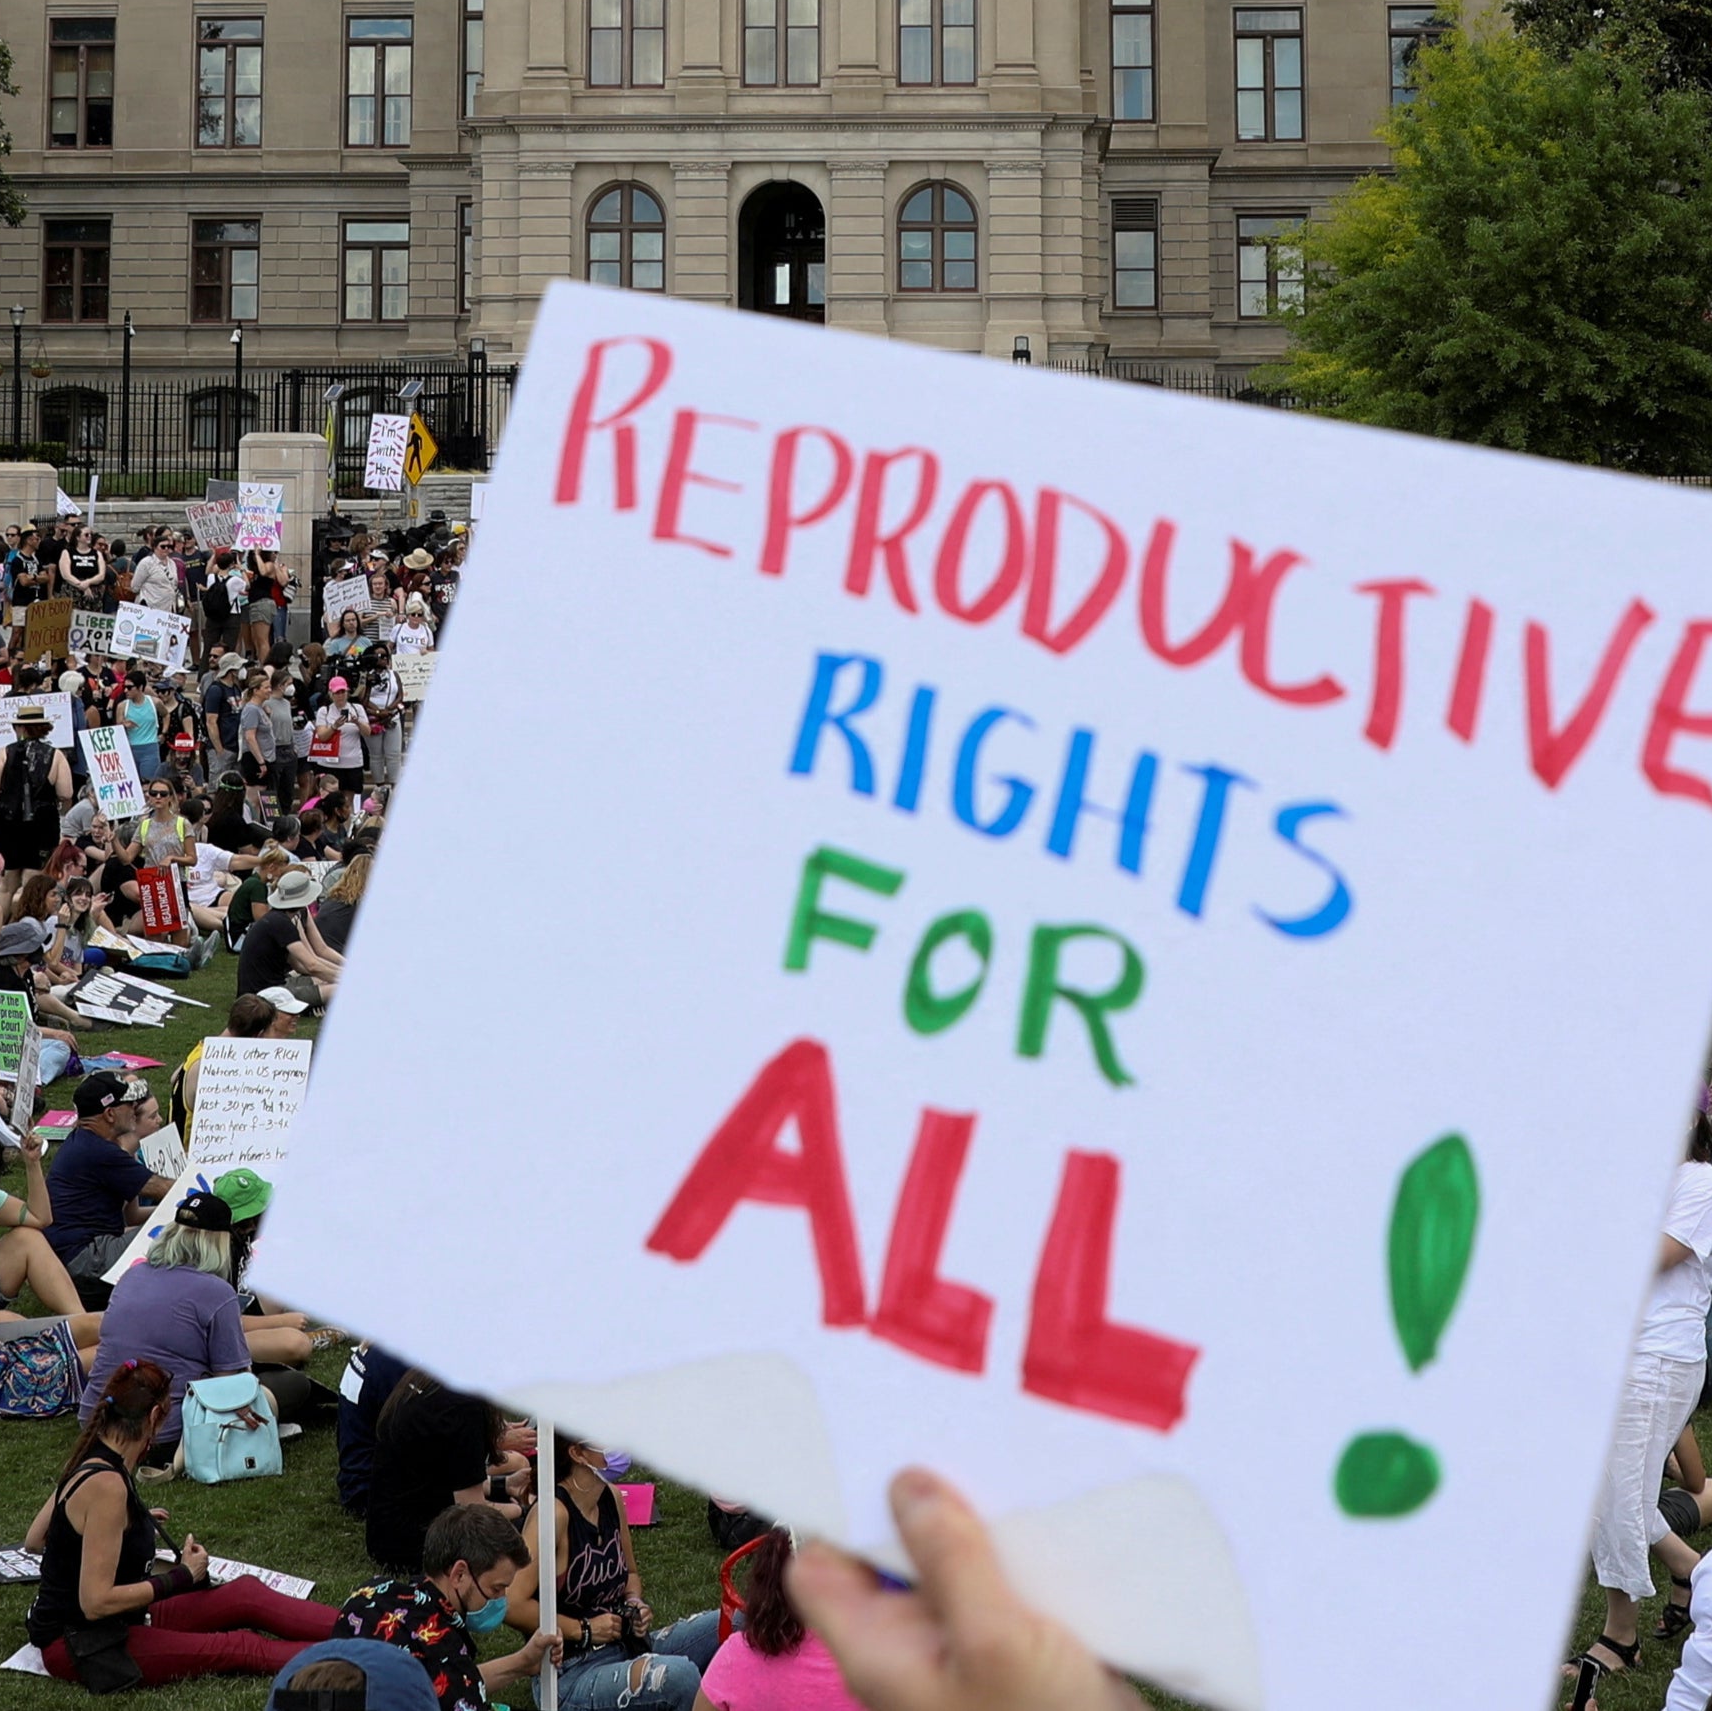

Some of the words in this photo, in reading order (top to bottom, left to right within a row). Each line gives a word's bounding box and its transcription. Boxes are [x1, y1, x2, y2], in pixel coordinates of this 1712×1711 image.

[380, 425, 396, 438] I'm
[374, 443, 396, 458] with
[374, 462, 391, 476] Her
[156, 618, 180, 630] Person
[167, 613, 180, 623] Not
[87, 629, 113, 640] FOR
[135, 625, 160, 637] Person
[4, 698, 24, 709] HAD
[26, 697, 35, 706] A
[89, 727, 115, 751] KEEP
[94, 752, 123, 773] YOUR
[99, 785, 114, 800] OFF
[117, 780, 135, 799] MY
[789, 650, 1355, 940] RIGHTS
[141, 884, 157, 927] ABORTIONS
[156, 880, 173, 926] HEALTHCARE
[782, 845, 1148, 1089] FOR
[7, 996, 19, 1006] the
[1, 1019, 20, 1032] Court
[204, 1044, 237, 1061] Unlike
[242, 1047, 271, 1061] other
[274, 1046, 300, 1061] RICH
[245, 1067, 254, 1077] in
[257, 1066, 270, 1078] US
[279, 1089, 289, 1097] in
[198, 1099, 220, 1112] last
[241, 1102, 255, 1117] yrs
[192, 1149, 234, 1165] Support
[643, 1038, 1201, 1434] ALL
[565, 1529, 627, 1604] fuck
